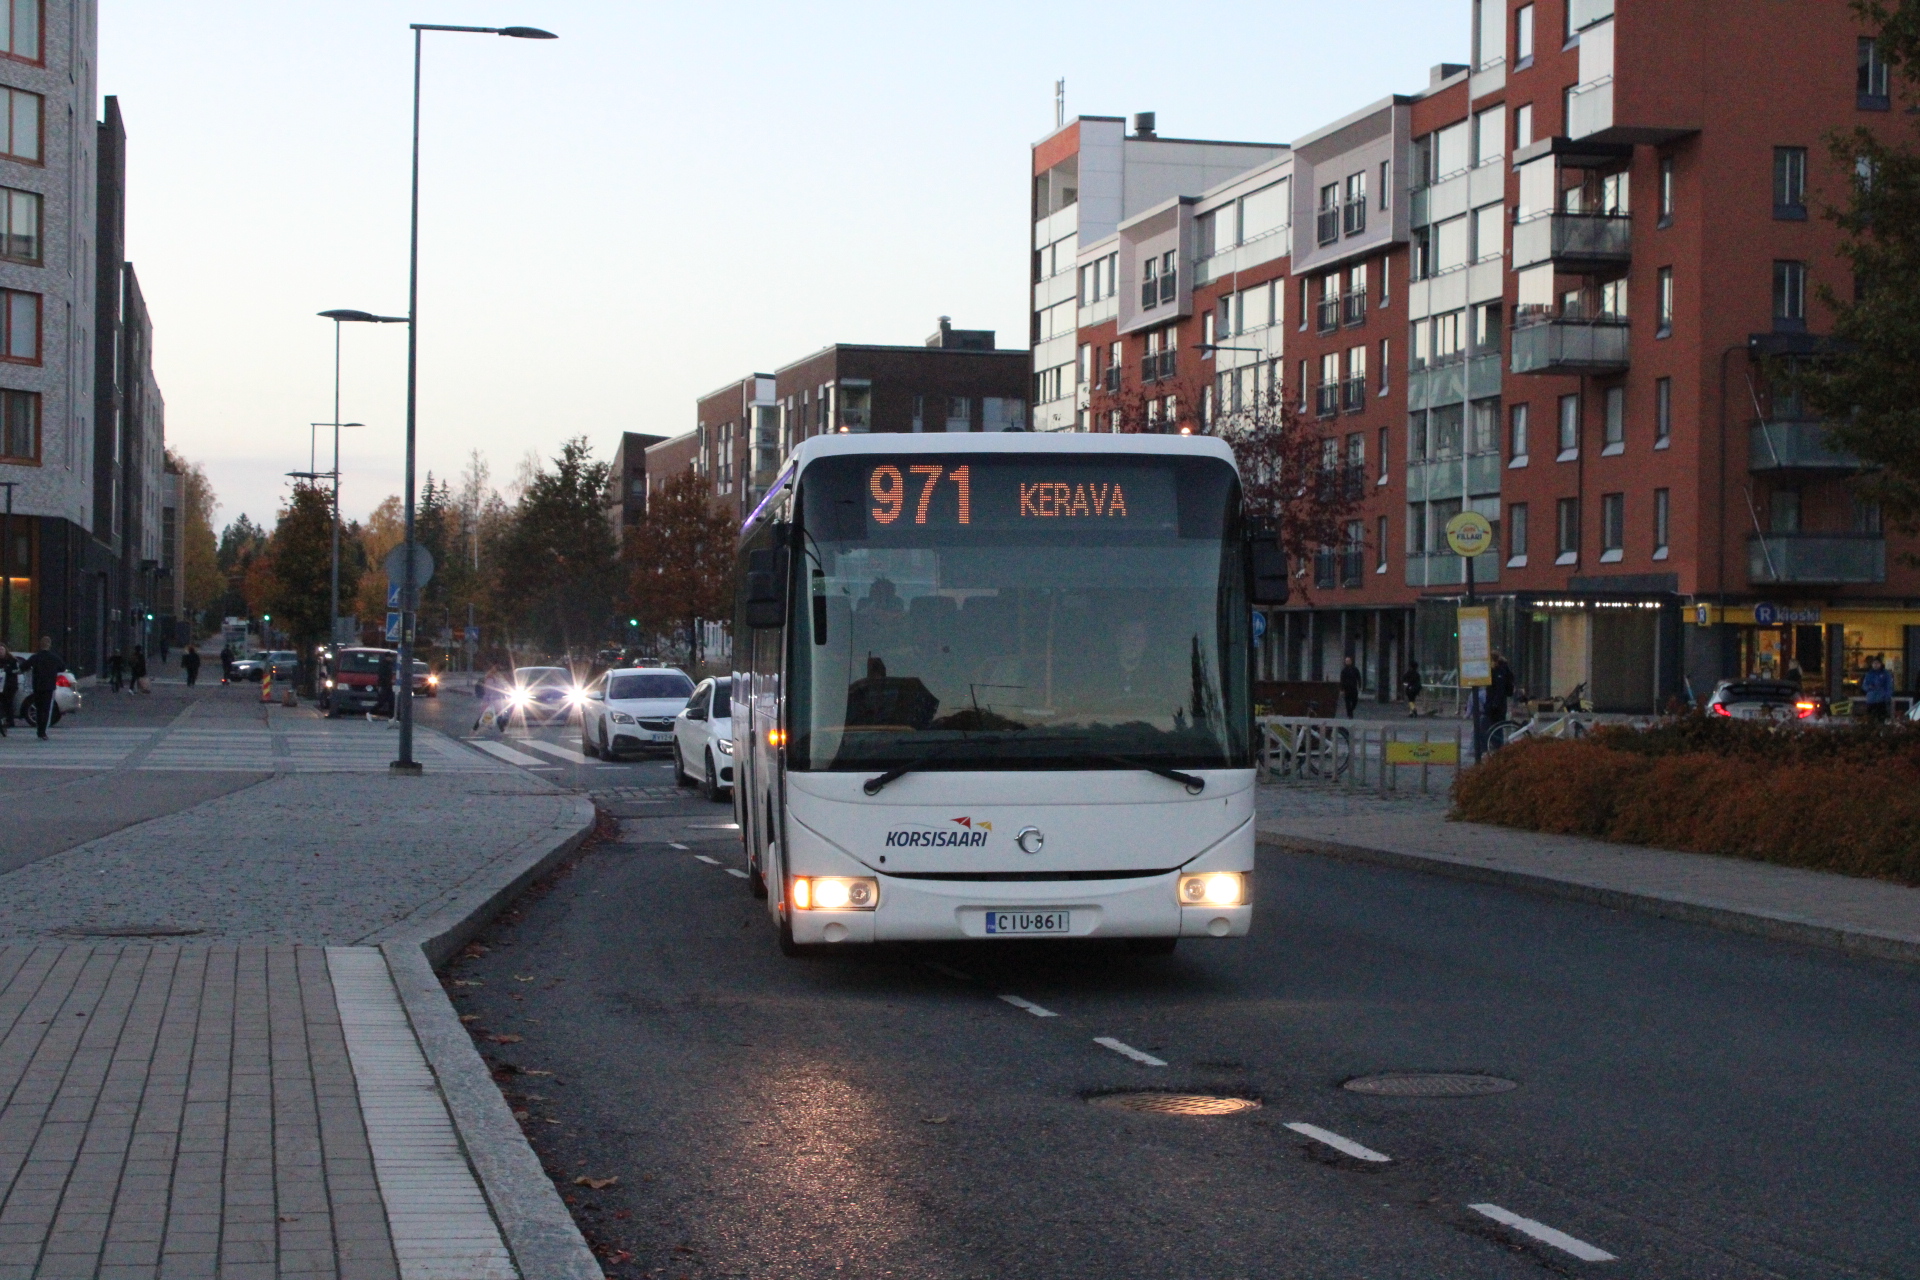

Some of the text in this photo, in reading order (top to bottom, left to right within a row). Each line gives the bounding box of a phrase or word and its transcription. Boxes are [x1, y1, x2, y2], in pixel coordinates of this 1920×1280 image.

[869, 464, 1127, 524] 971 KERAVA
[1776, 606, 1819, 622] kioski
[885, 831, 988, 847] KORSISAARI
[998, 914, 1062, 930] CIU-861
